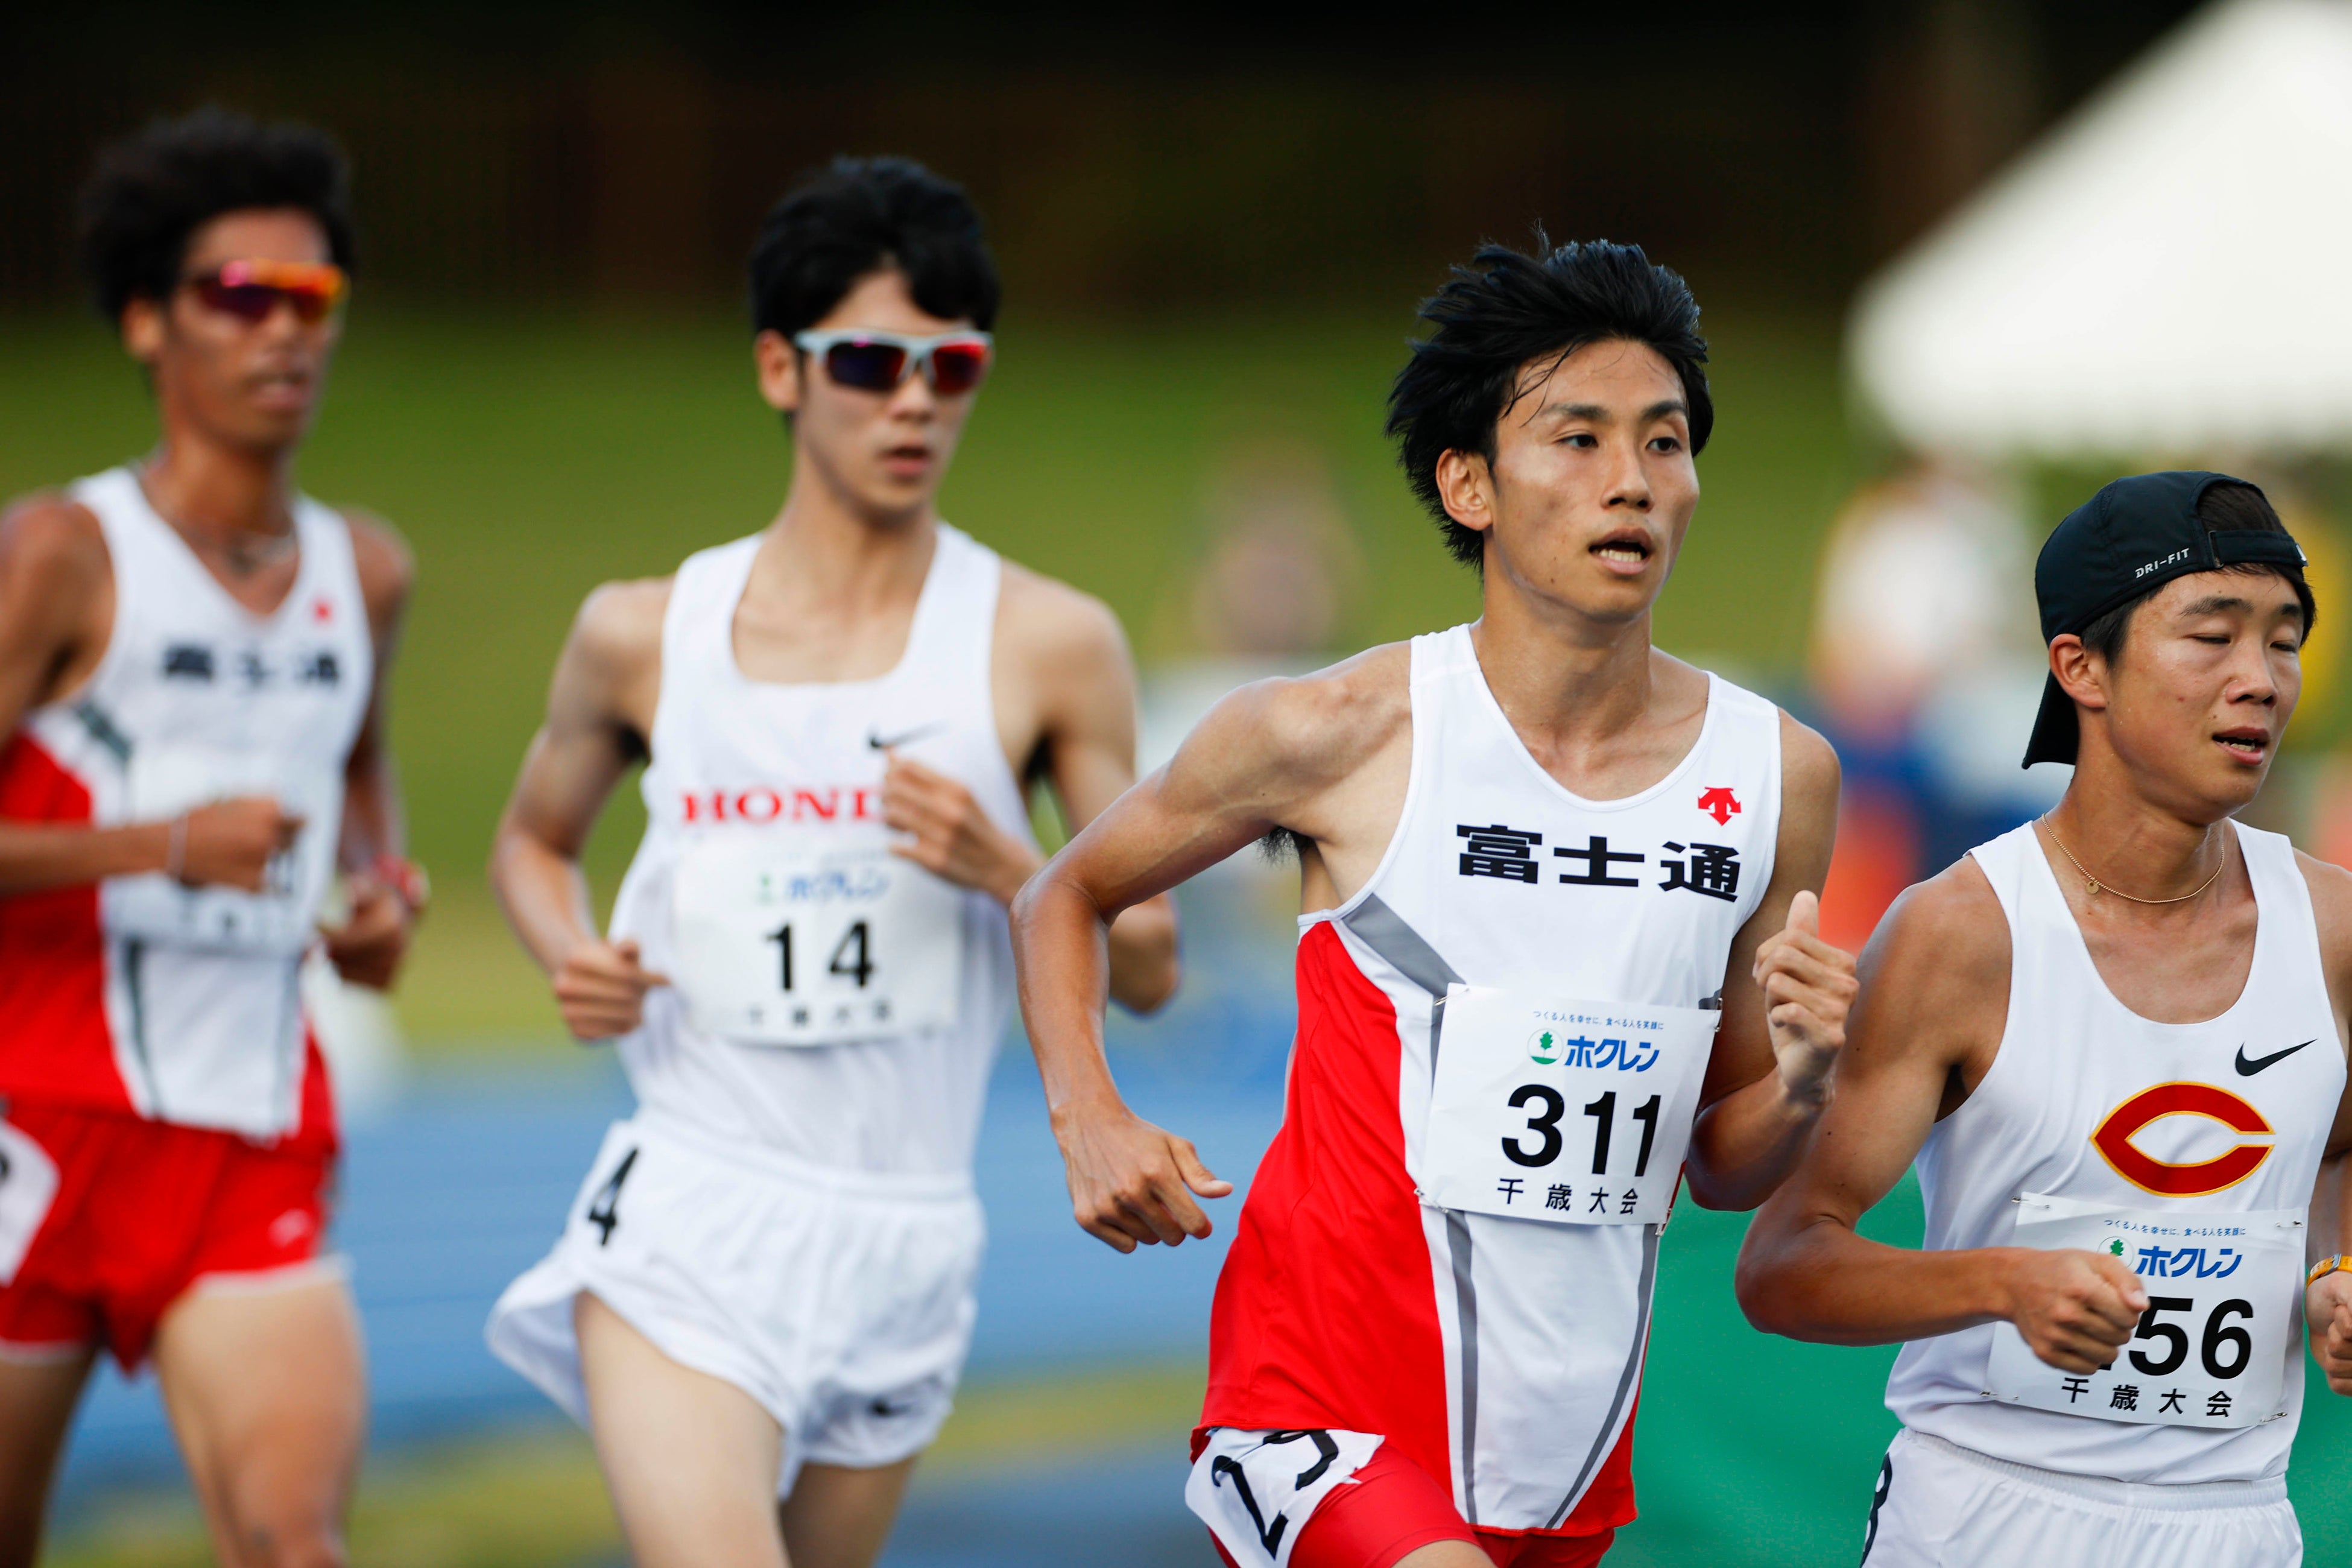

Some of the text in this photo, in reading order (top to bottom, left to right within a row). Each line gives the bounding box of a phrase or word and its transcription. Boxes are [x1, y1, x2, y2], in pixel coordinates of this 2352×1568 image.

[2135, 548, 2190, 578] DRI-FIT
[681, 786, 885, 824] HOND
[1456, 824, 1742, 903] 富士通
[765, 918, 876, 991] 14
[1564, 1035, 1660, 1072] ホクレン
[1501, 1084, 1661, 1178] 311
[588, 1146, 639, 1247] 4
[1497, 1178, 1639, 1215] 千歳大会
[2134, 1245, 2243, 1279] ホクレン
[2099, 1295, 2254, 1380] 56
[2061, 1377, 2233, 1417] 千歳大会
